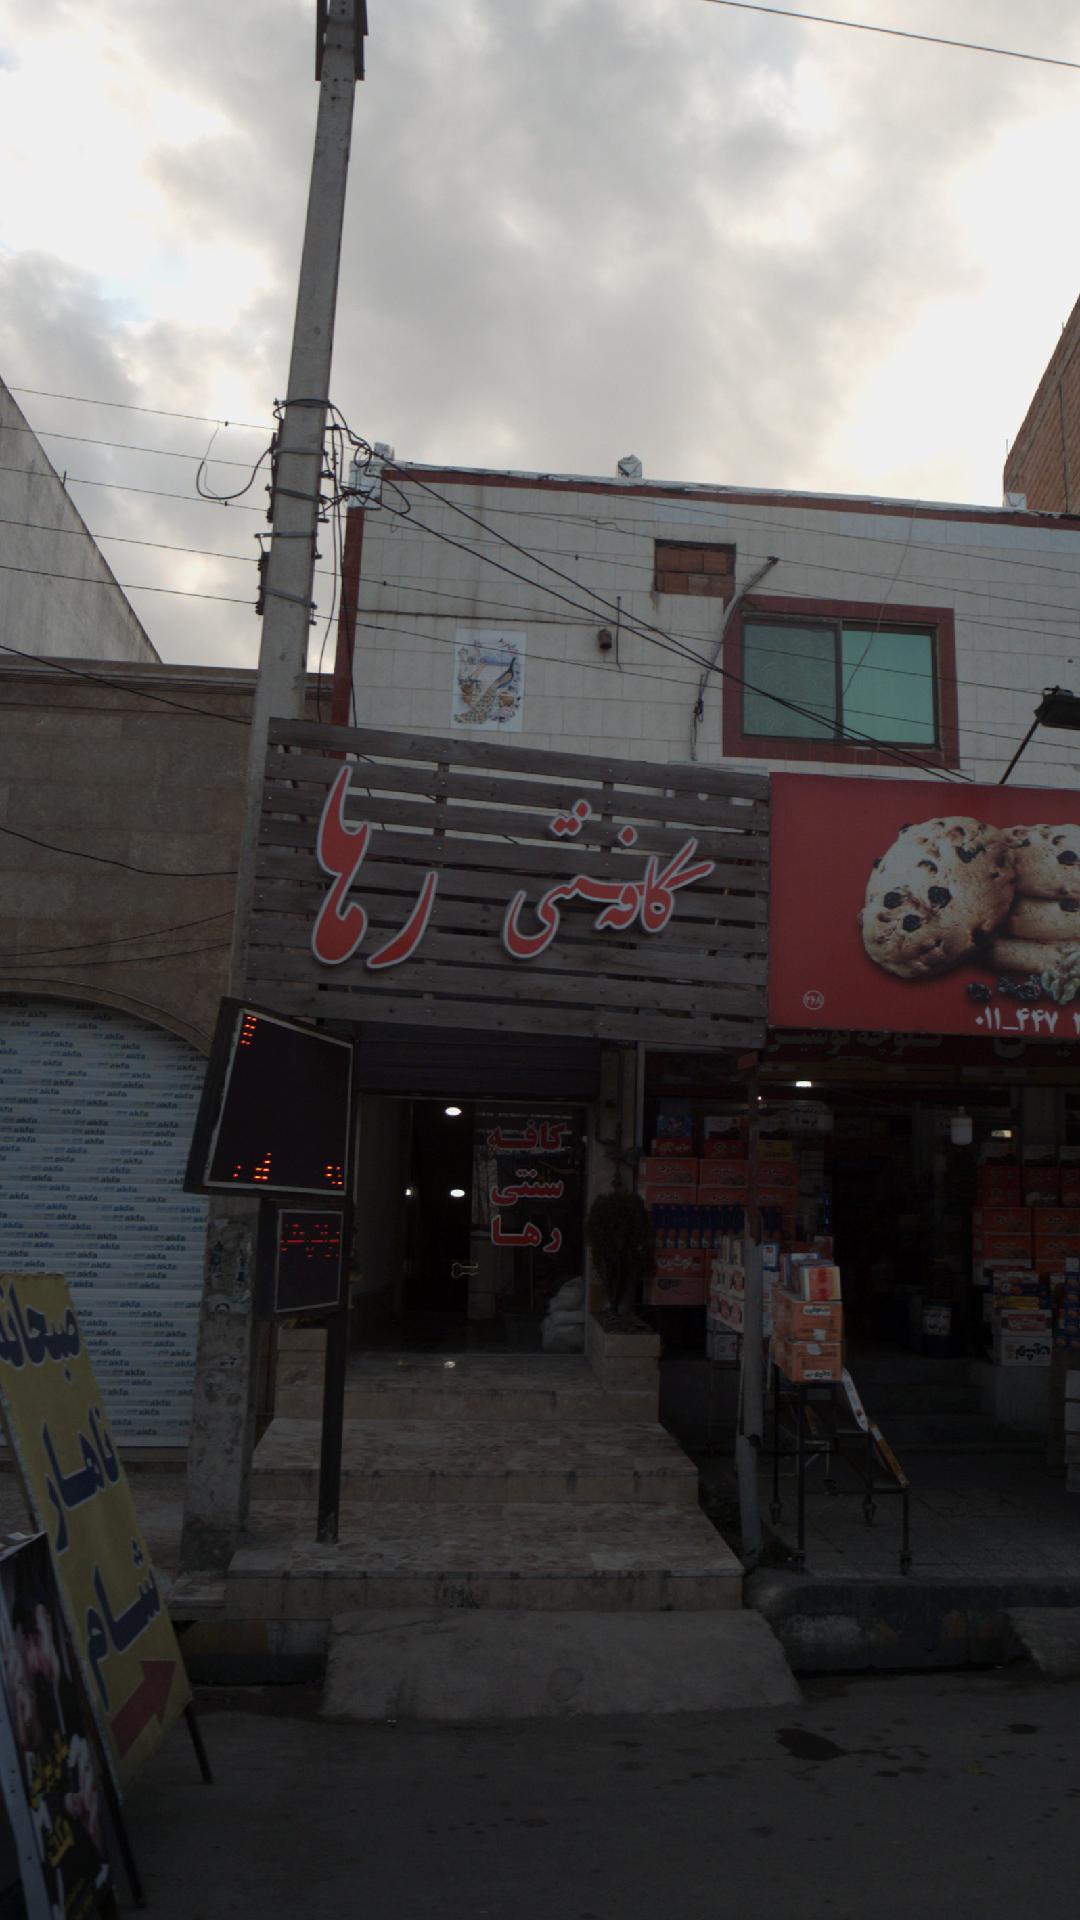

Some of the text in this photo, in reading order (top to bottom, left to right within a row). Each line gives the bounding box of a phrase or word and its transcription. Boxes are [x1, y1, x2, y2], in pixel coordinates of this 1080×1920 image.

[311, 764, 439, 972] رها
[487, 1119, 573, 1152] کافه
[490, 1167, 565, 1205] سنتی
[491, 1213, 562, 1254] رها
[42, 1405, 120, 1554] ناهار
[86, 1539, 161, 1711] شام
